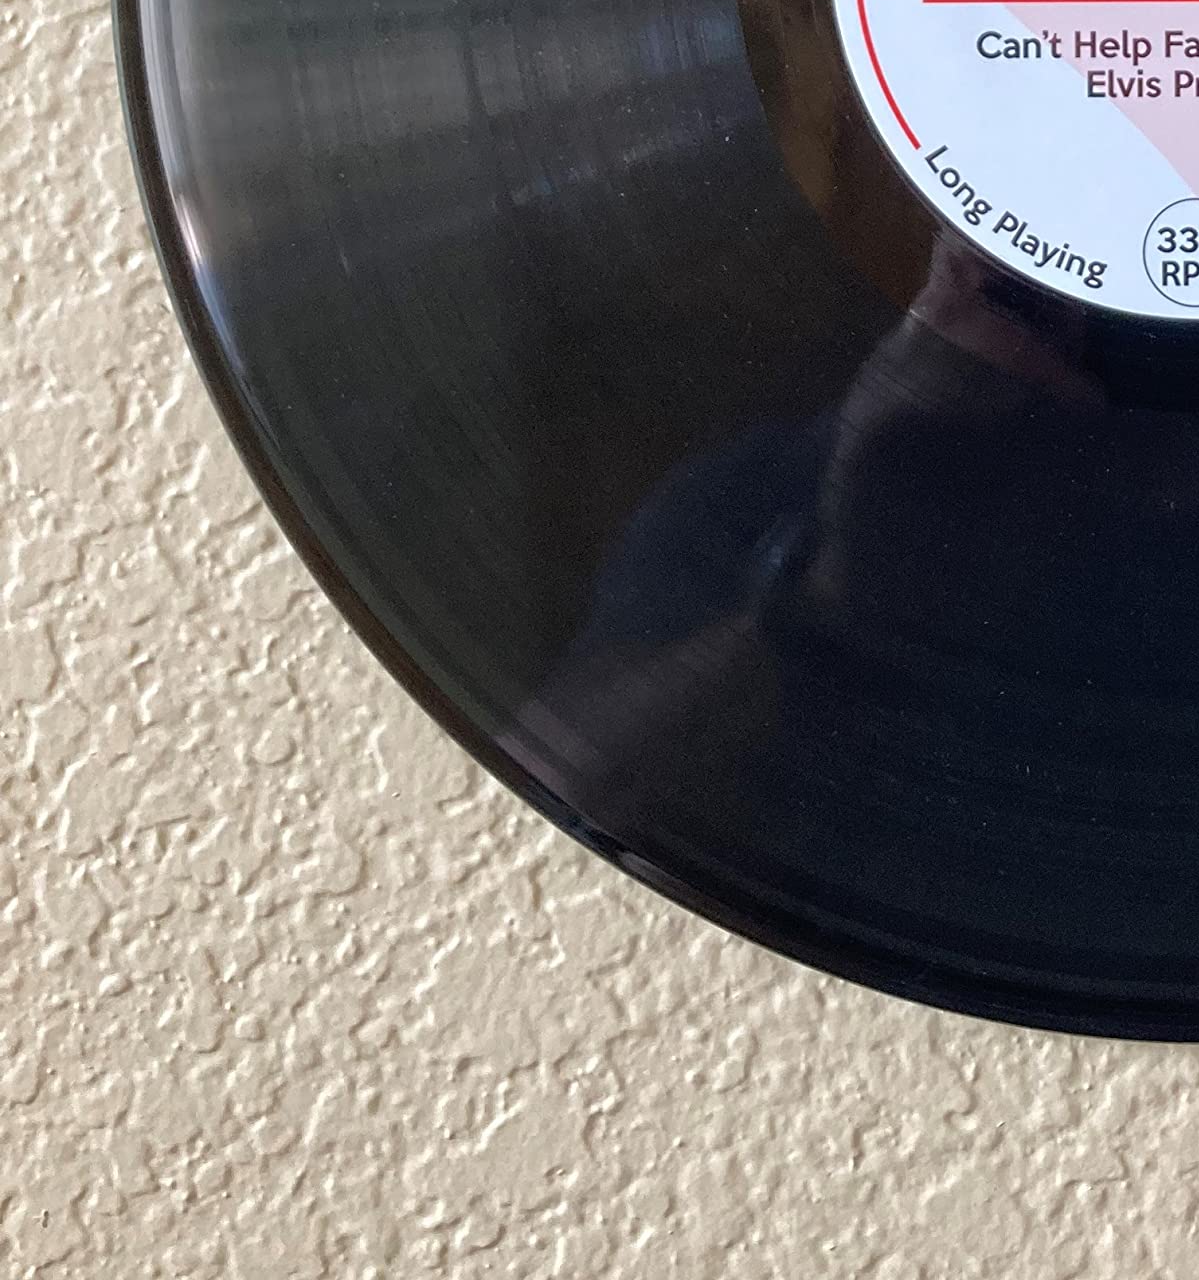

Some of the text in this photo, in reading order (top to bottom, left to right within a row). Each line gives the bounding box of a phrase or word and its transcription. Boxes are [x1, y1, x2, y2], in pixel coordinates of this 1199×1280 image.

[976, 30, 1062, 60] Can't
[1075, 29, 1152, 67] Help
[1087, 69, 1162, 98] Elvis
[924, 144, 1108, 289] Long Playing
[1157, 226, 1199, 254] 33
